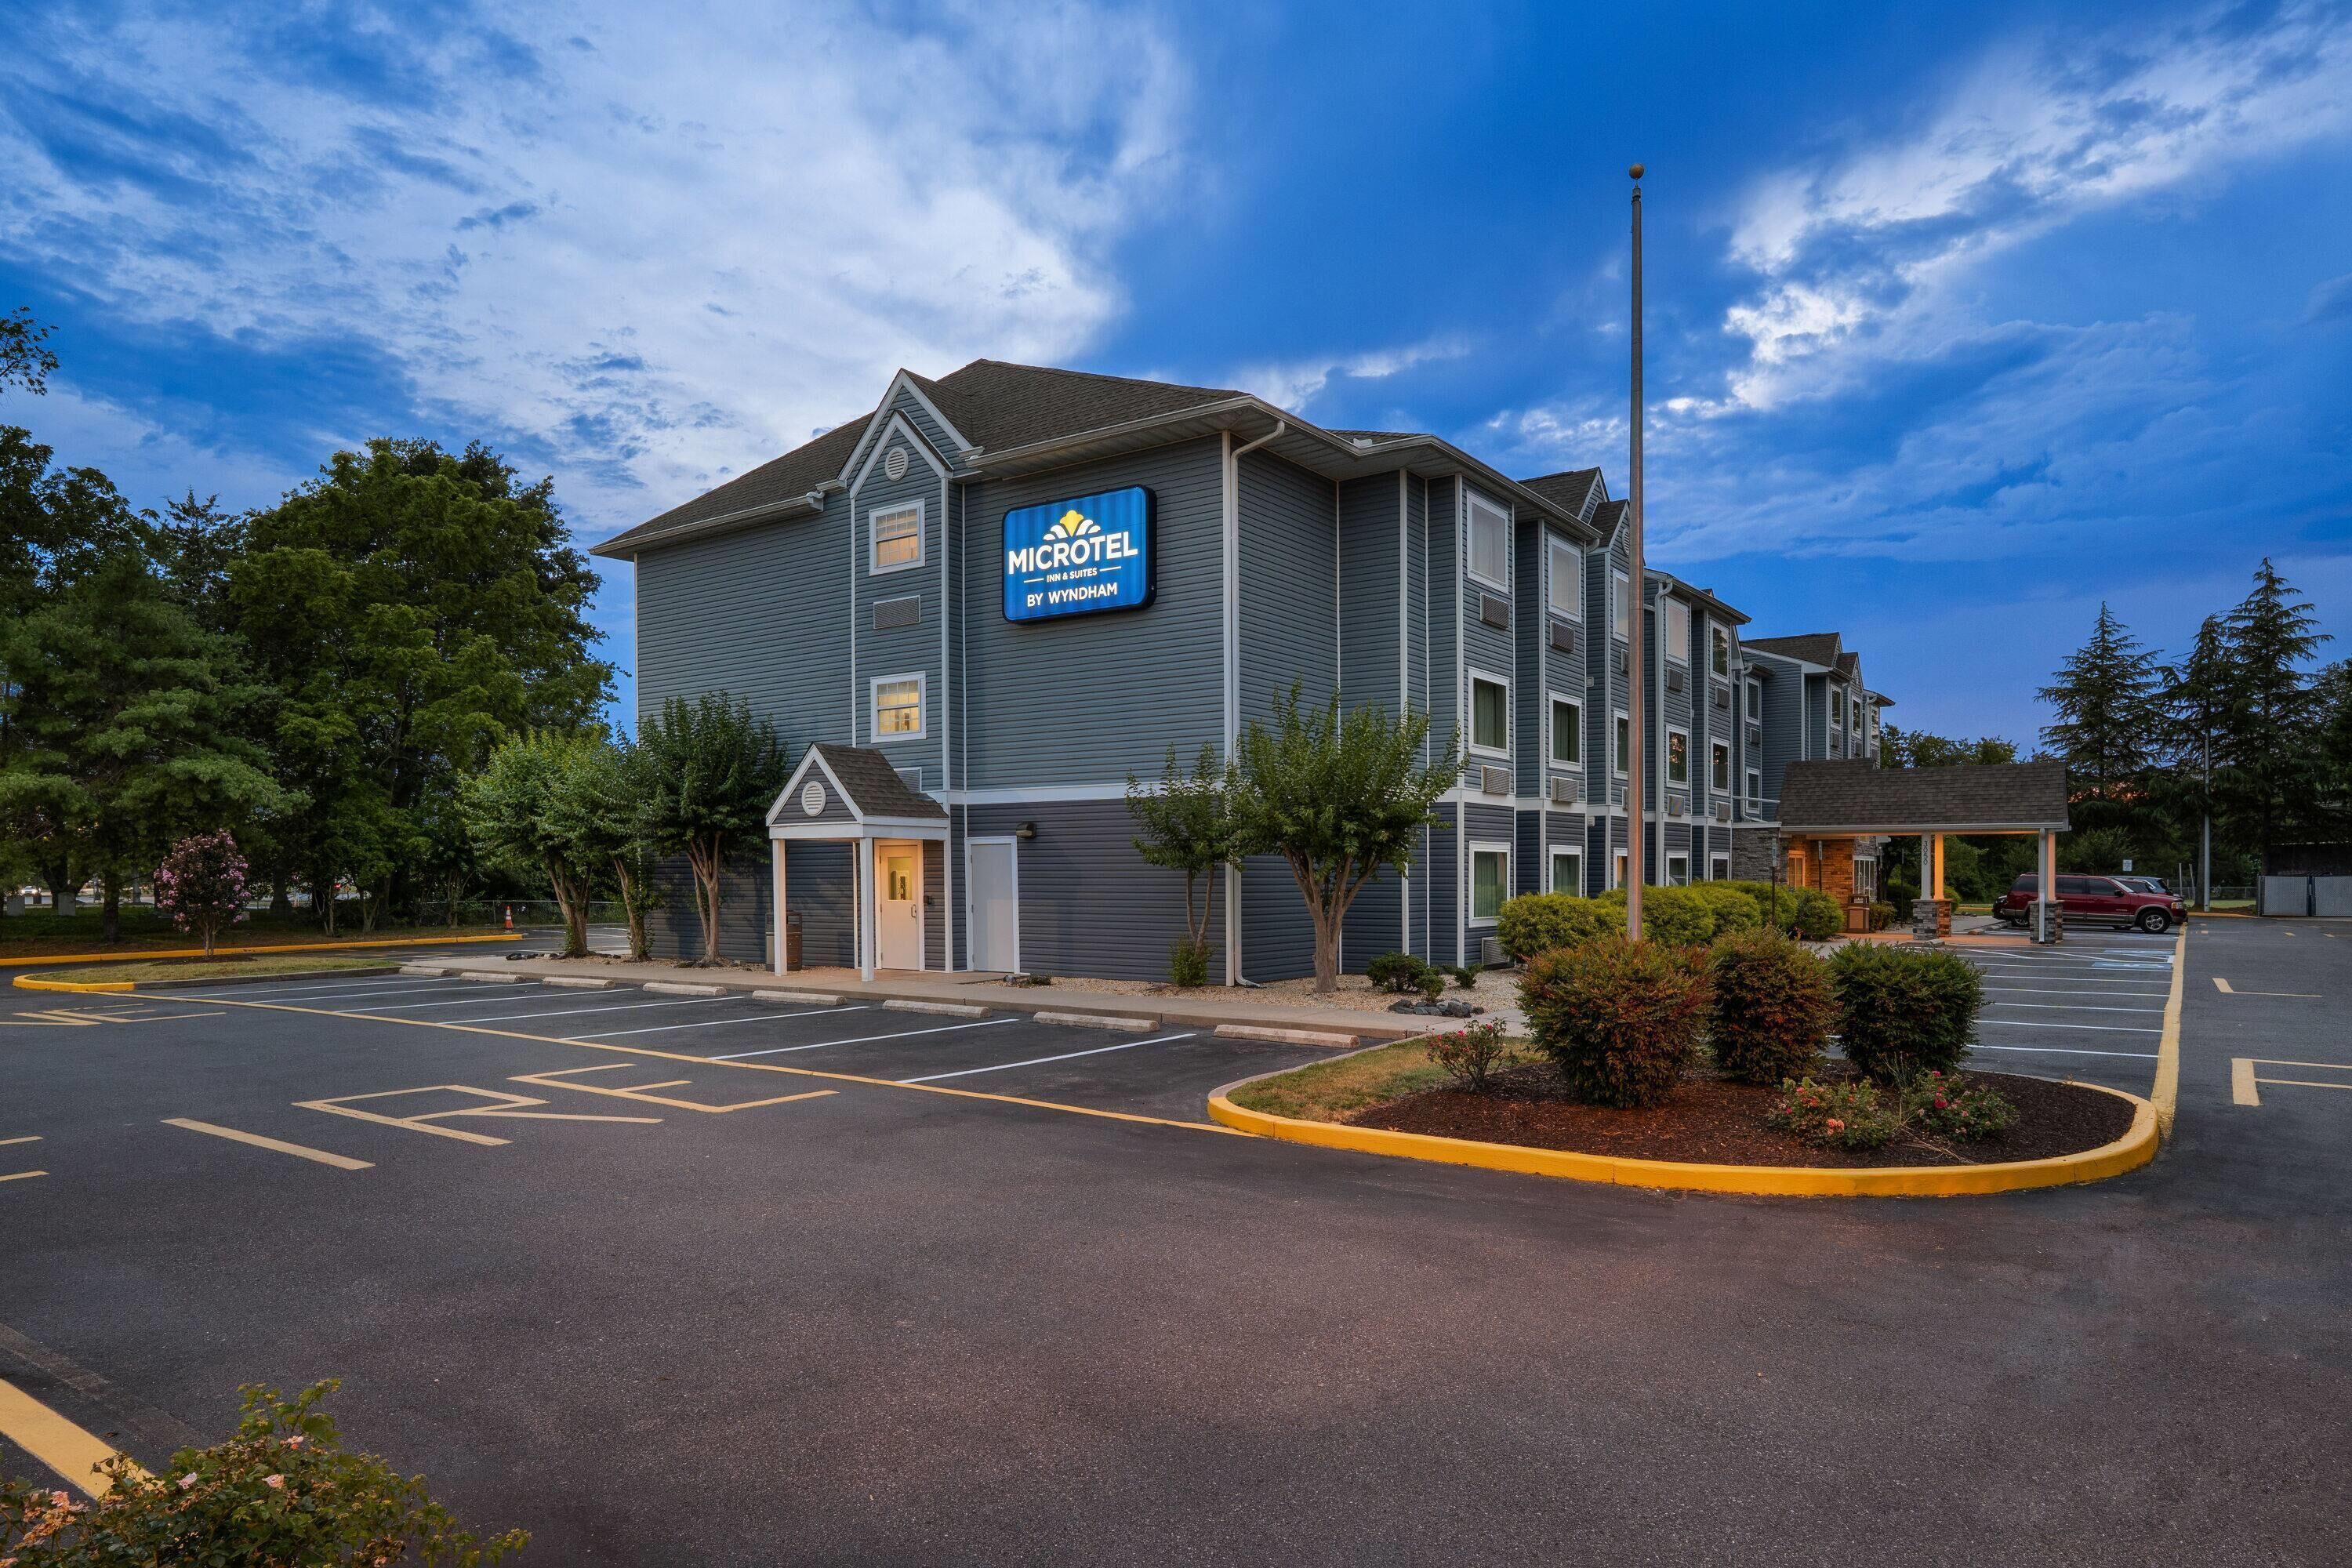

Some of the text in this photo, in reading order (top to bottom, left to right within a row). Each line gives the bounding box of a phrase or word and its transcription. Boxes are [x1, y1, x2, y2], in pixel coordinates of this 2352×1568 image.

[1008, 532, 1138, 575] MICROTEL
[1047, 568, 1098, 583] INN & SUITES
[1027, 582, 1117, 607] BY WYNDHAM
